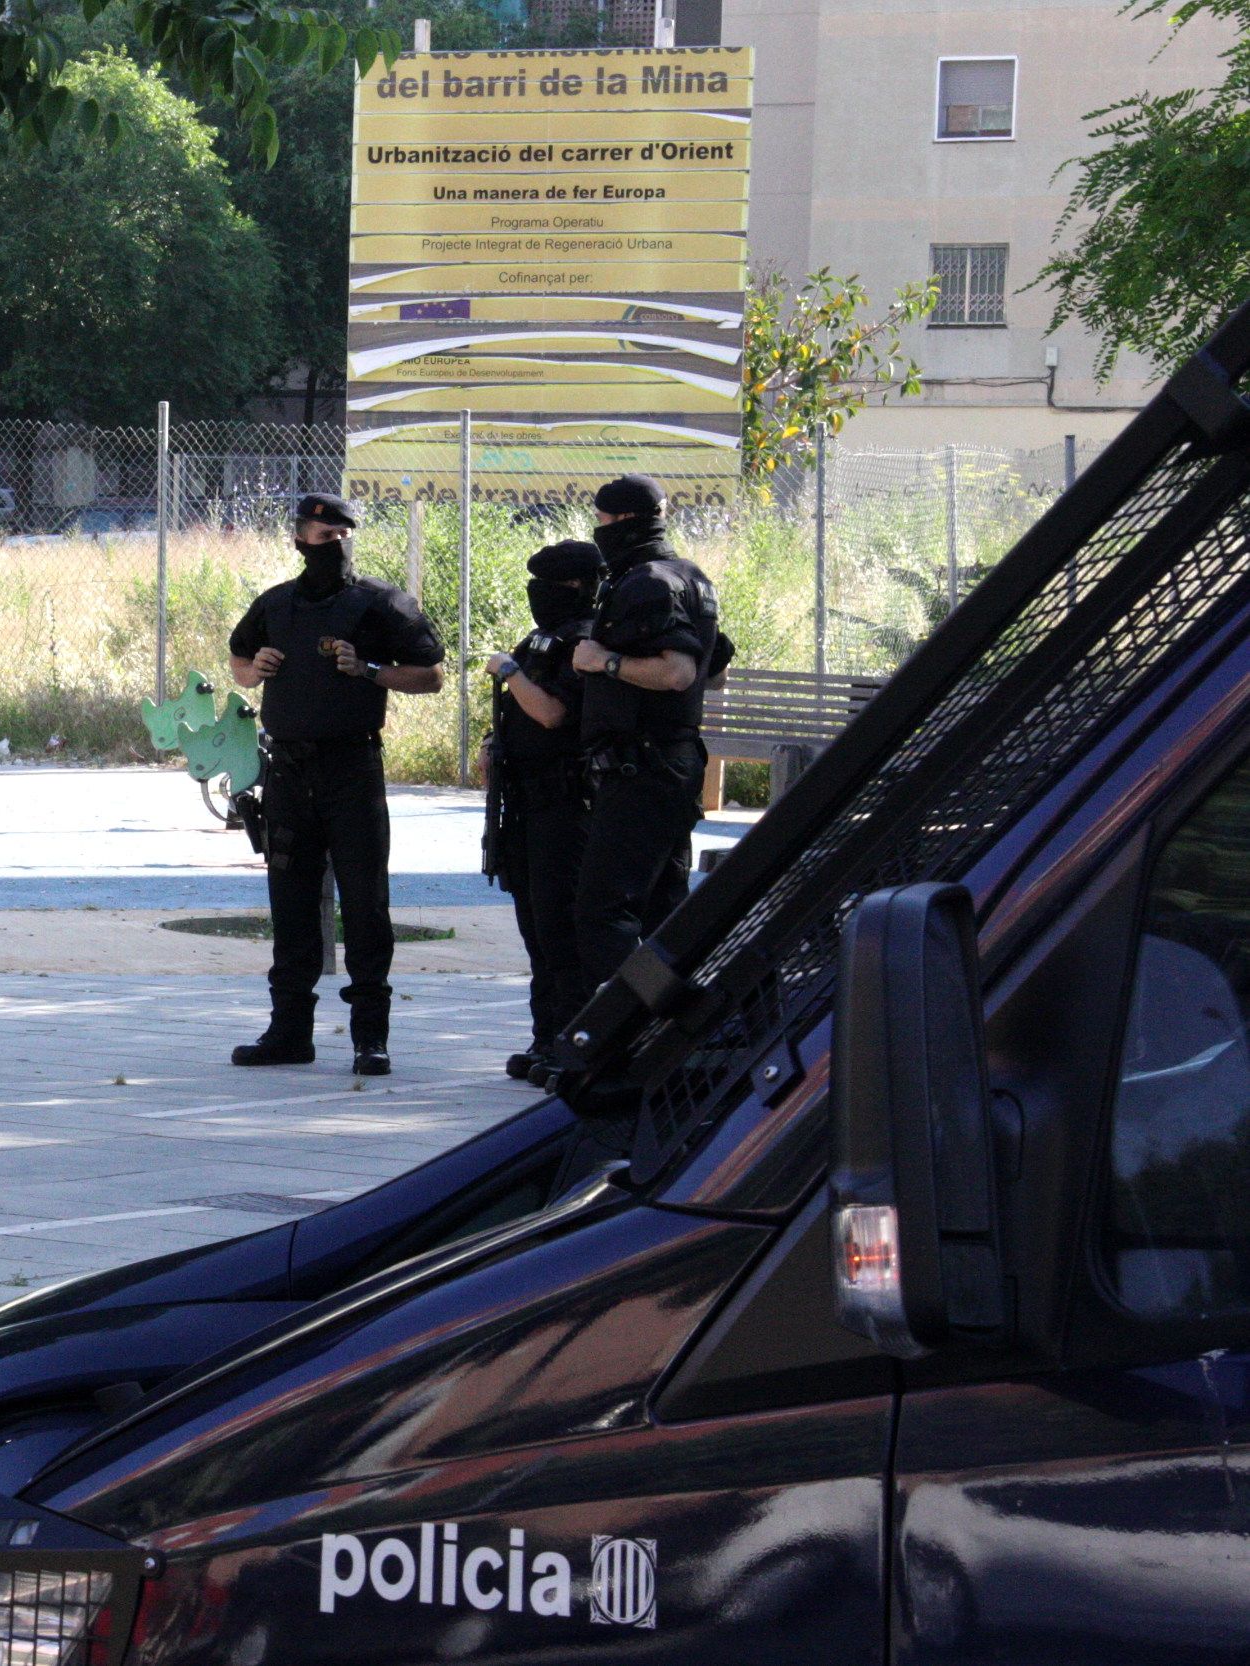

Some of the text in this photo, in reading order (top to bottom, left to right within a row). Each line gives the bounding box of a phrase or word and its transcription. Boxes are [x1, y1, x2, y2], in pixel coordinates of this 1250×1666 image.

[377, 65, 728, 99] del barri de la Mina
[367, 142, 734, 165] Urbanització del carrer d'Orient
[433, 186, 666, 203] Una manera de fer Europa
[491, 215, 604, 229] Programa Operatiu
[422, 237, 673, 252] Projecte Integrat de Regeneració Urbana
[498, 271, 594, 286] Cofinançat per:
[319, 1522, 571, 1617] policia
